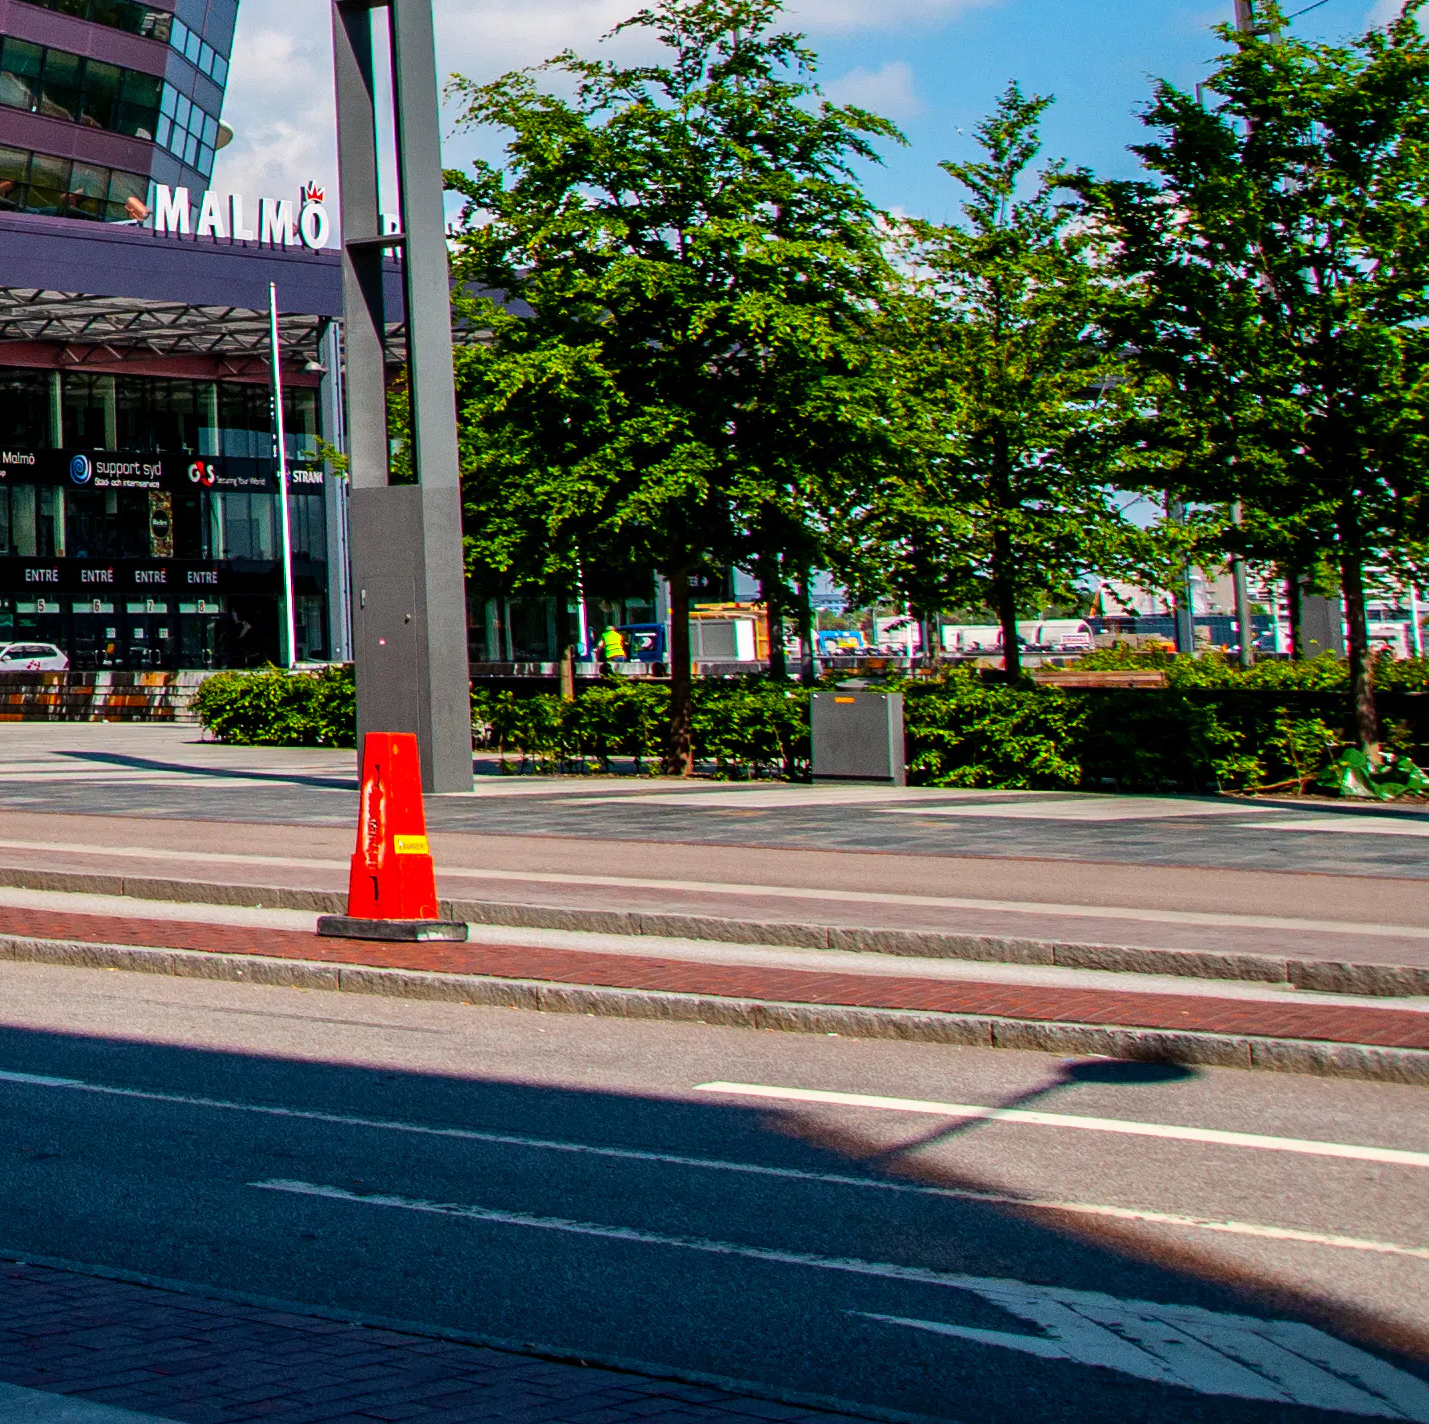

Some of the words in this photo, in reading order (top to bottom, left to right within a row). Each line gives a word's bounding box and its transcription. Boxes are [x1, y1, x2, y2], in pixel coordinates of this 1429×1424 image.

[2, 450, 36, 466] Malmö
[96, 461, 141, 478] support
[143, 460, 162, 480] syd
[94, 600, 100, 612] 6
[147, 601, 154, 612] 7
